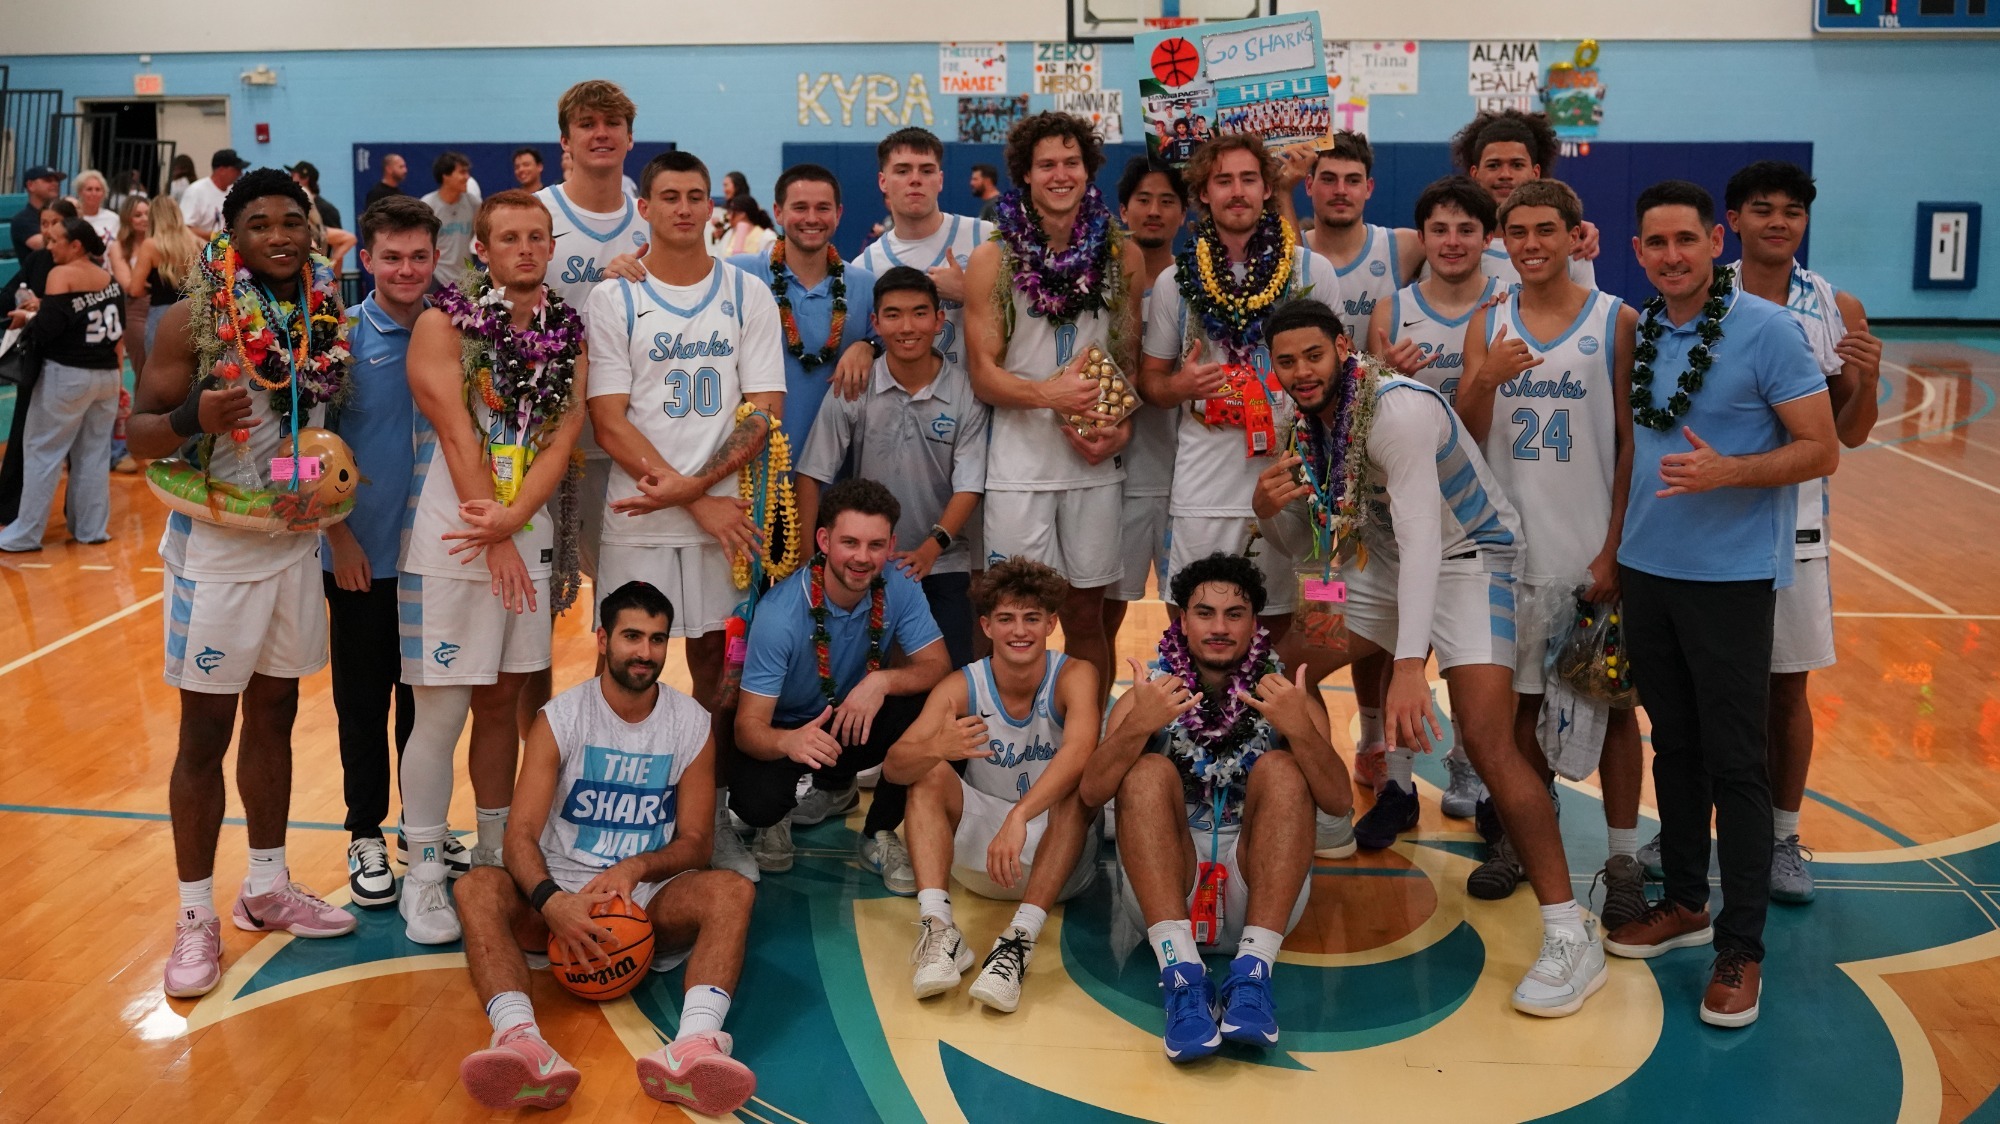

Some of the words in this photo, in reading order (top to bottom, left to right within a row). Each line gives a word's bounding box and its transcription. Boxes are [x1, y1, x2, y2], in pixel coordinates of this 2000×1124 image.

[1878, 15, 1900, 28] TOL
[1038, 43, 1095, 61] ZERO
[1206, 39, 1238, 65] GO
[1245, 24, 1313, 61] SHARKS
[1473, 43, 1539, 62] ALANA
[1045, 63, 1057, 73] IS
[1065, 63, 1083, 74] MY
[1362, 54, 1408, 67] Tiana
[943, 76, 995, 91] TANABE
[1041, 74, 1093, 93] HERO
[1178, 88, 1209, 98] PACIFIC
[1240, 78, 1311, 100] HPU
[1479, 71, 1538, 93] BALLA
[798, 72, 934, 126] KYRA
[1148, 96, 1210, 113] UPSET
[561, 255, 606, 283] Sha
[85, 303, 122, 343] 30
[649, 330, 734, 361] Sharks
[664, 367, 722, 418] 30
[1500, 369, 1587, 400] Sharks
[1512, 408, 1572, 462] 24
[604, 753, 653, 785] THE
[1016, 772, 1031, 799] 1
[564, 956, 637, 985] Wilson
